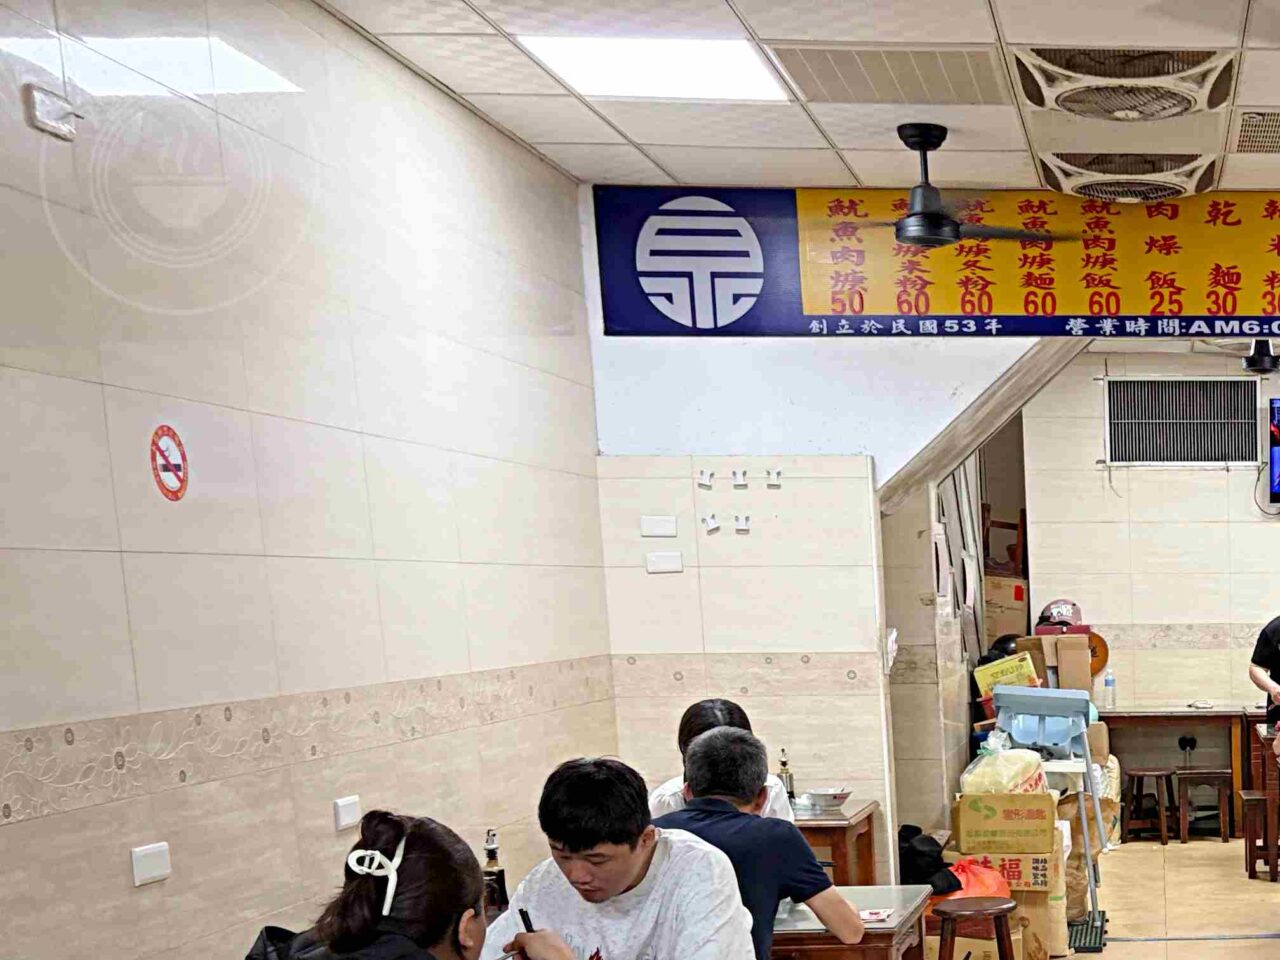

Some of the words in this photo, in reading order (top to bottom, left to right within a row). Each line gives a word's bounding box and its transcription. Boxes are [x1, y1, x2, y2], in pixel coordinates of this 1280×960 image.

[1144, 201, 1186, 291] 肉燥飯
[1204, 200, 1242, 291] 乾麵
[831, 289, 864, 315] 50
[896, 290, 930, 316] 60
[960, 289, 993, 316] 60
[1023, 290, 1057, 317] 60
[1088, 290, 1121, 317] 60
[1149, 289, 1184, 316] 25
[1205, 290, 1237, 316] 30
[808, 318, 1003, 336] 創立於民國53年
